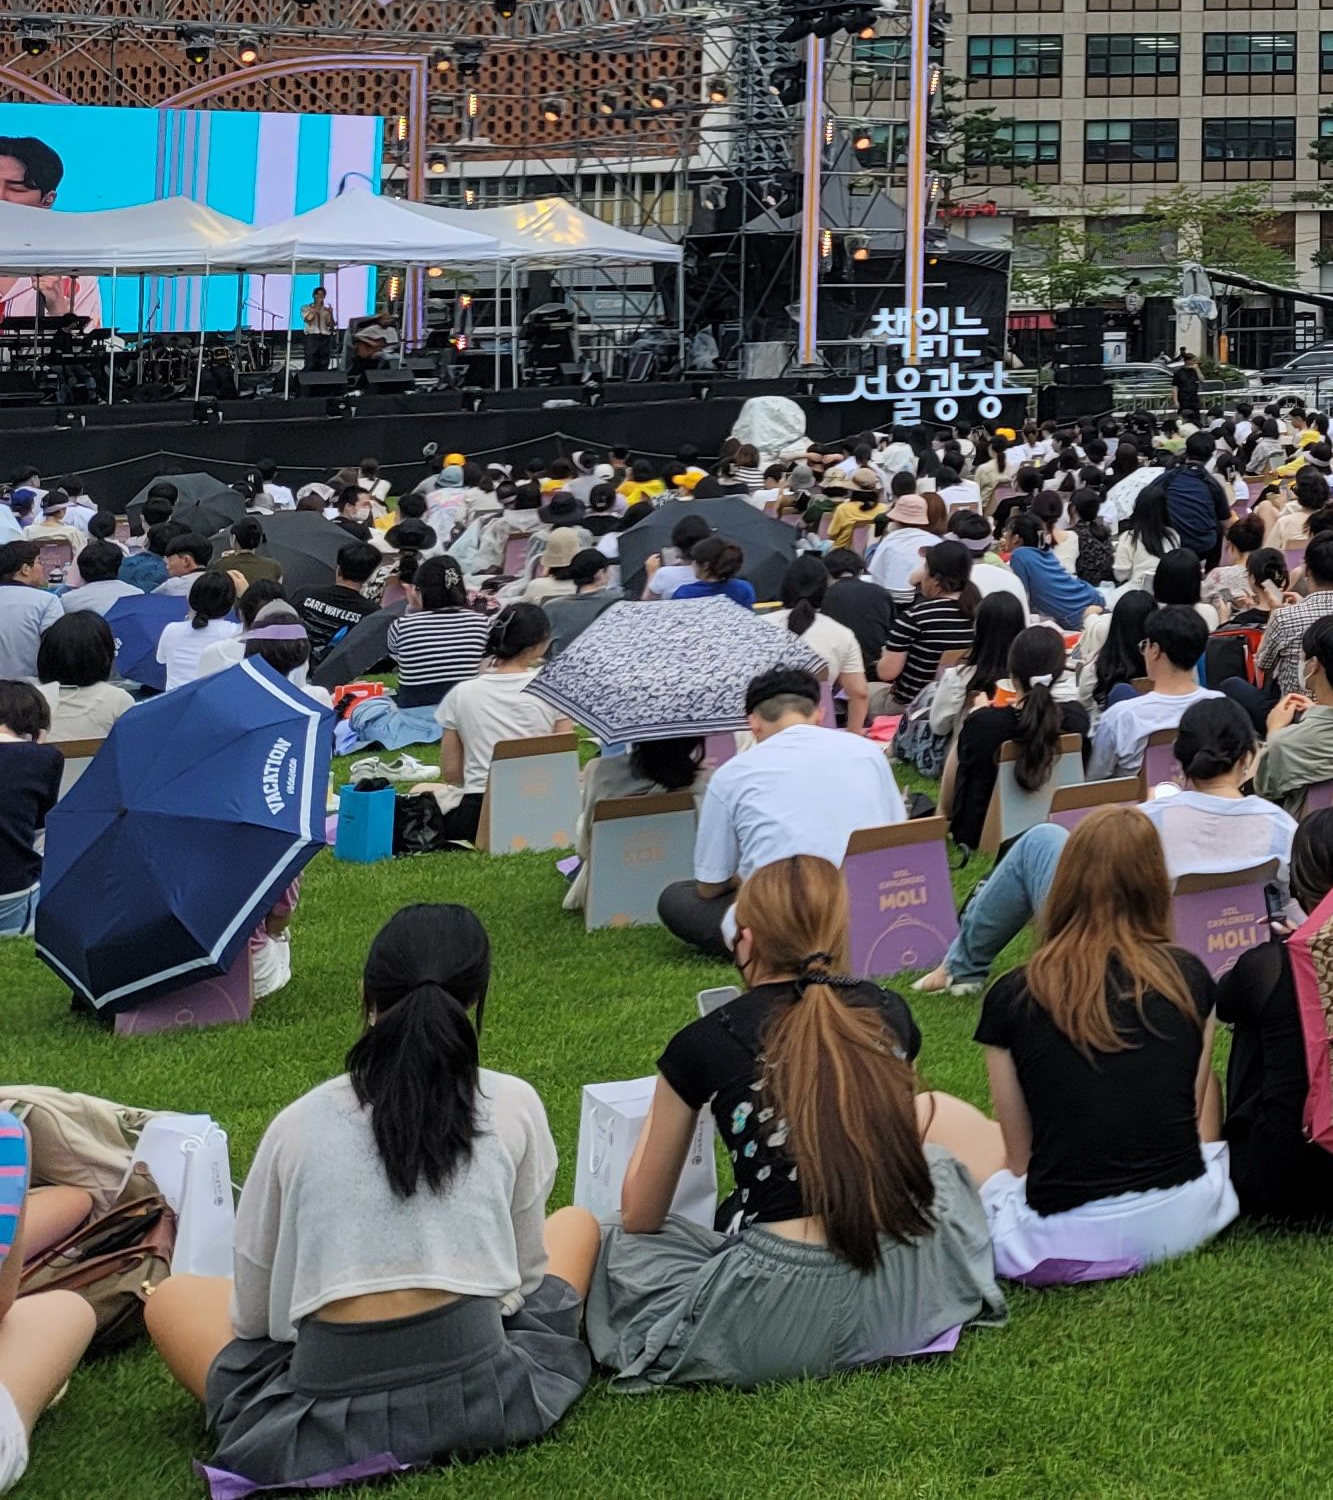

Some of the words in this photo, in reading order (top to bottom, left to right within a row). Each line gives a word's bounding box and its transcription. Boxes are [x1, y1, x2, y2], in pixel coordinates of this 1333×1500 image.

[819, 361, 1033, 426] 서울광장
[303, 597, 326, 612] CARE
[324, 604, 342, 618] WAY
[340, 610, 362, 624] LESS
[262, 737, 292, 816] VACATION
[879, 886, 928, 912] MOLI
[1207, 926, 1257, 953] MOLI
